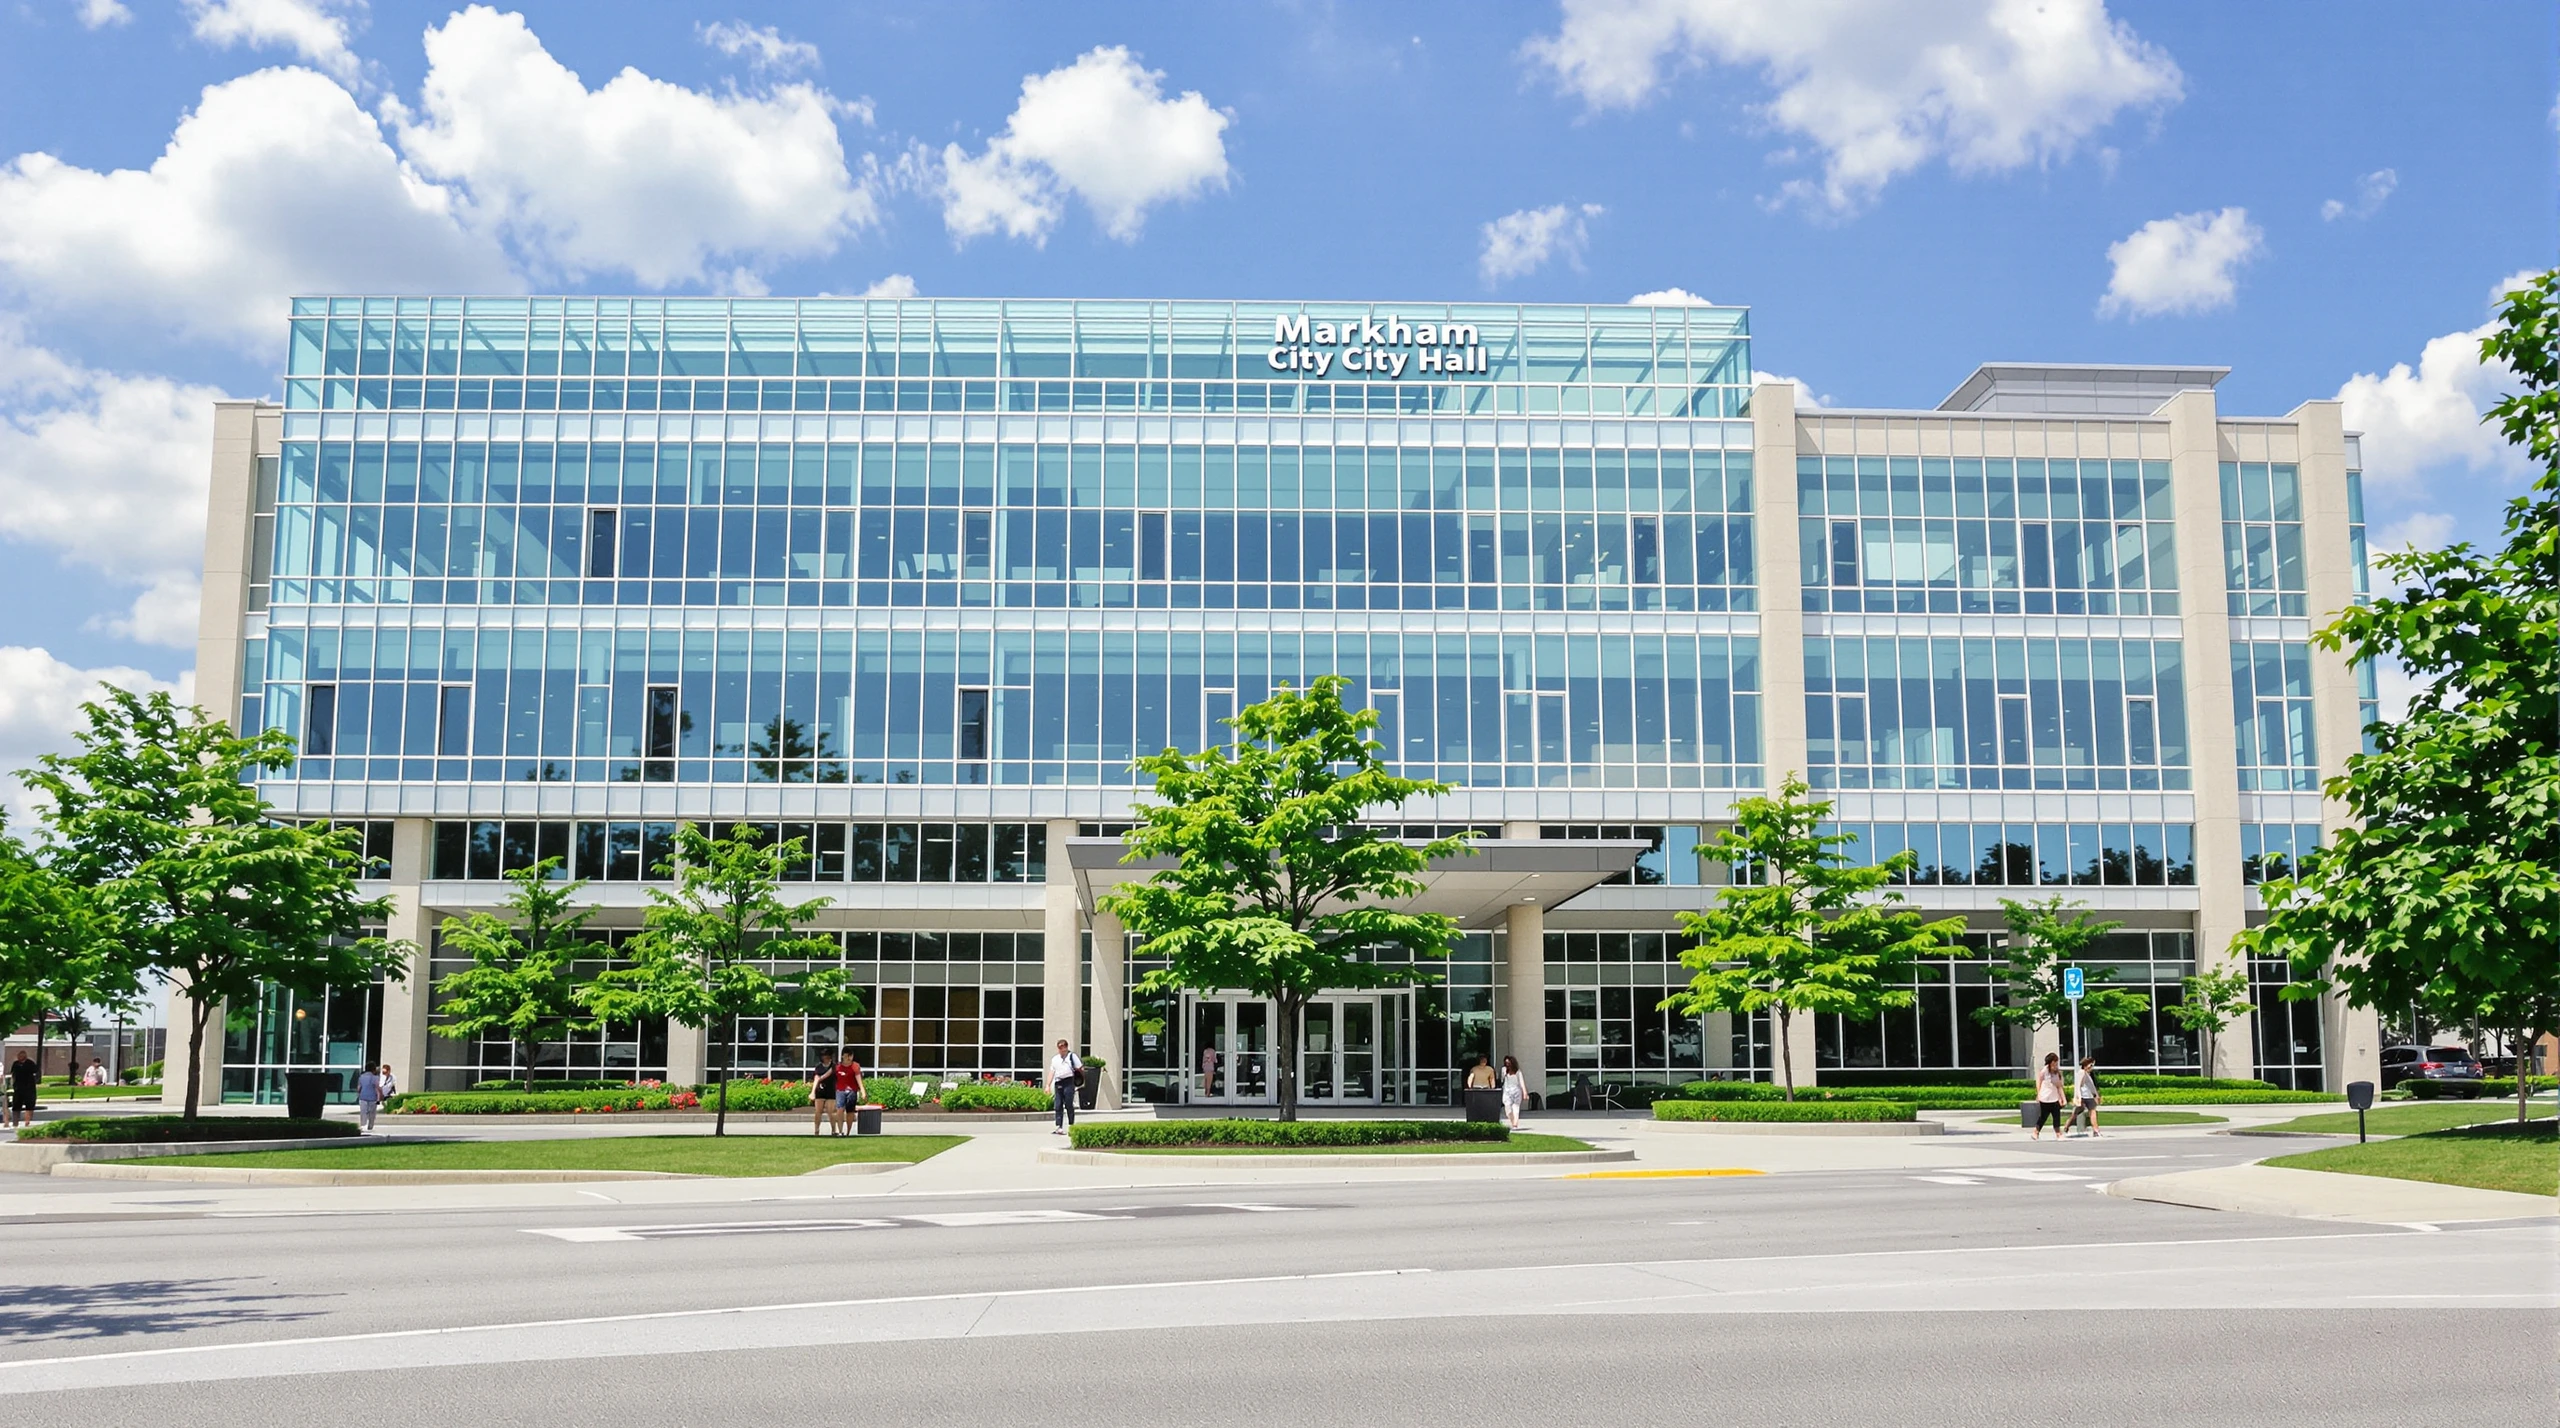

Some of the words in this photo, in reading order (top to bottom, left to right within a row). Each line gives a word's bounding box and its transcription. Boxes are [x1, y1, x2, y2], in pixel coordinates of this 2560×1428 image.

[1275, 314, 1478, 345] Markham
[1268, 346, 1334, 377] City
[1341, 346, 1408, 378] City
[1419, 347, 1488, 373] Hall
